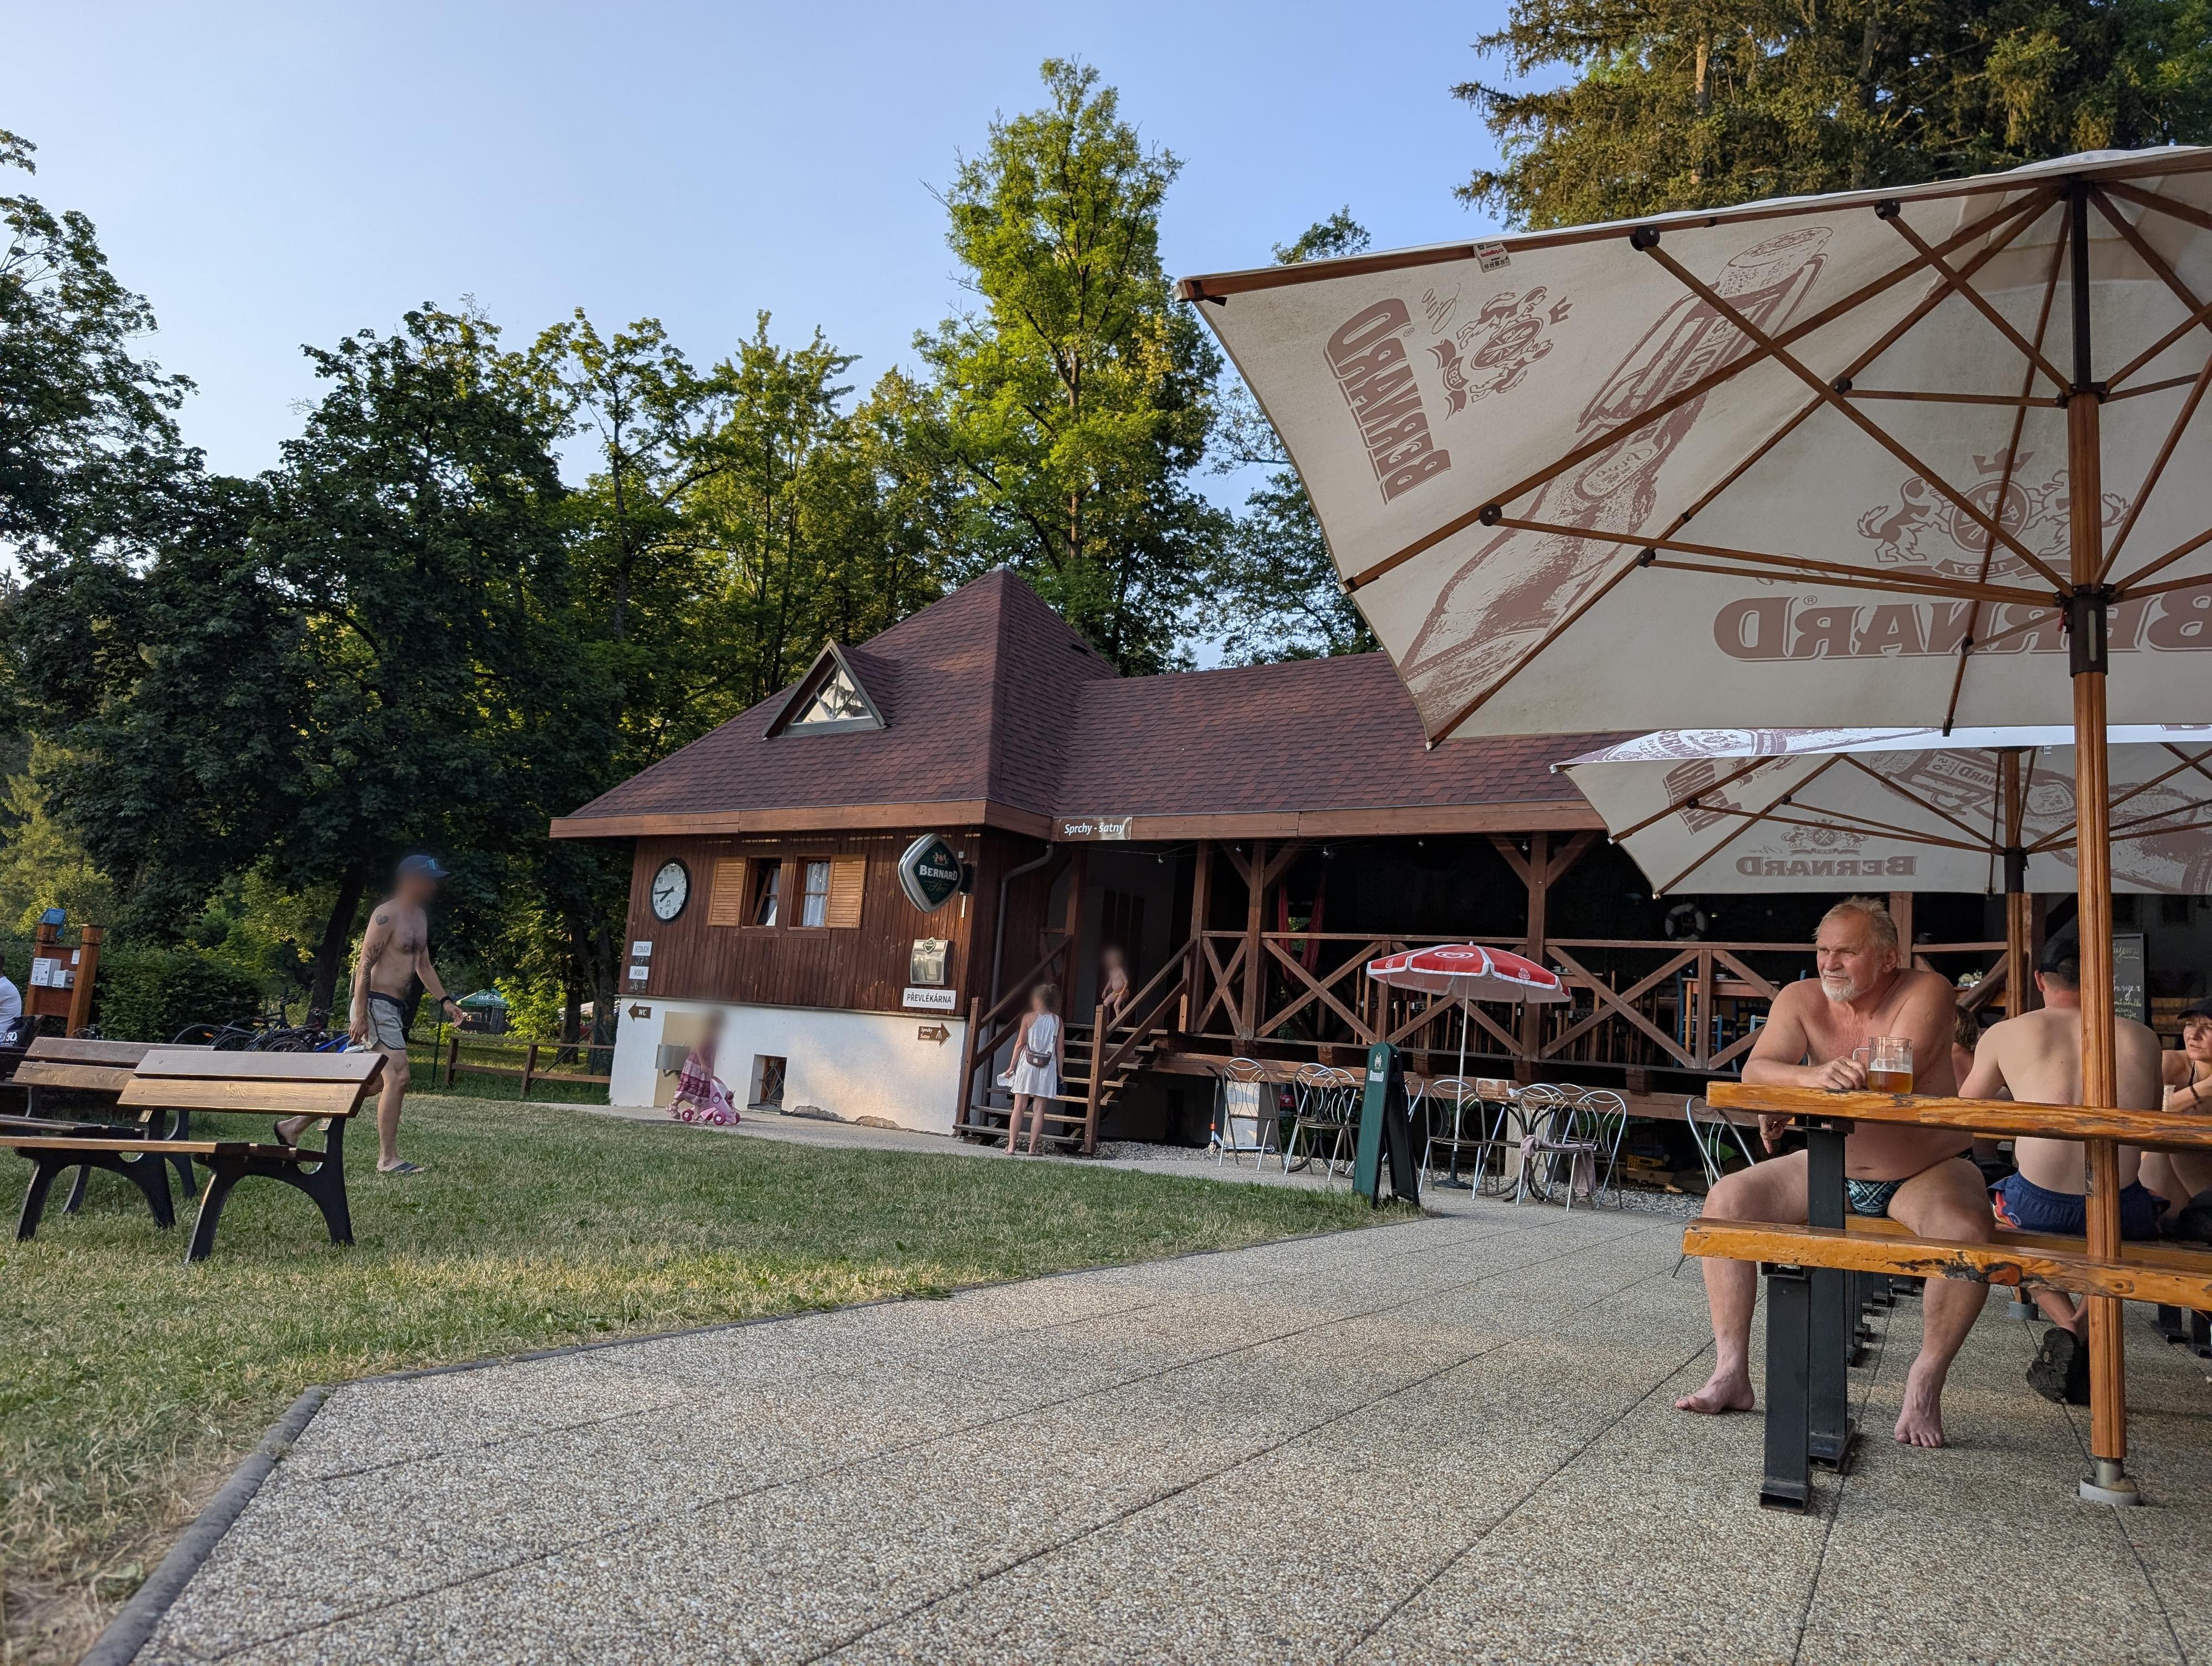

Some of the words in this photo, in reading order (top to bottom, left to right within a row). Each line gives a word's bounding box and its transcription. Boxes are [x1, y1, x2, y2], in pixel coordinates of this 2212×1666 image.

[1064, 822, 1093, 836] Sprchy
[1098, 822, 1125, 835] šatny
[919, 865, 958, 881] BERNARD
[907, 992, 952, 1003] PŘEVLÉKÁRNA
